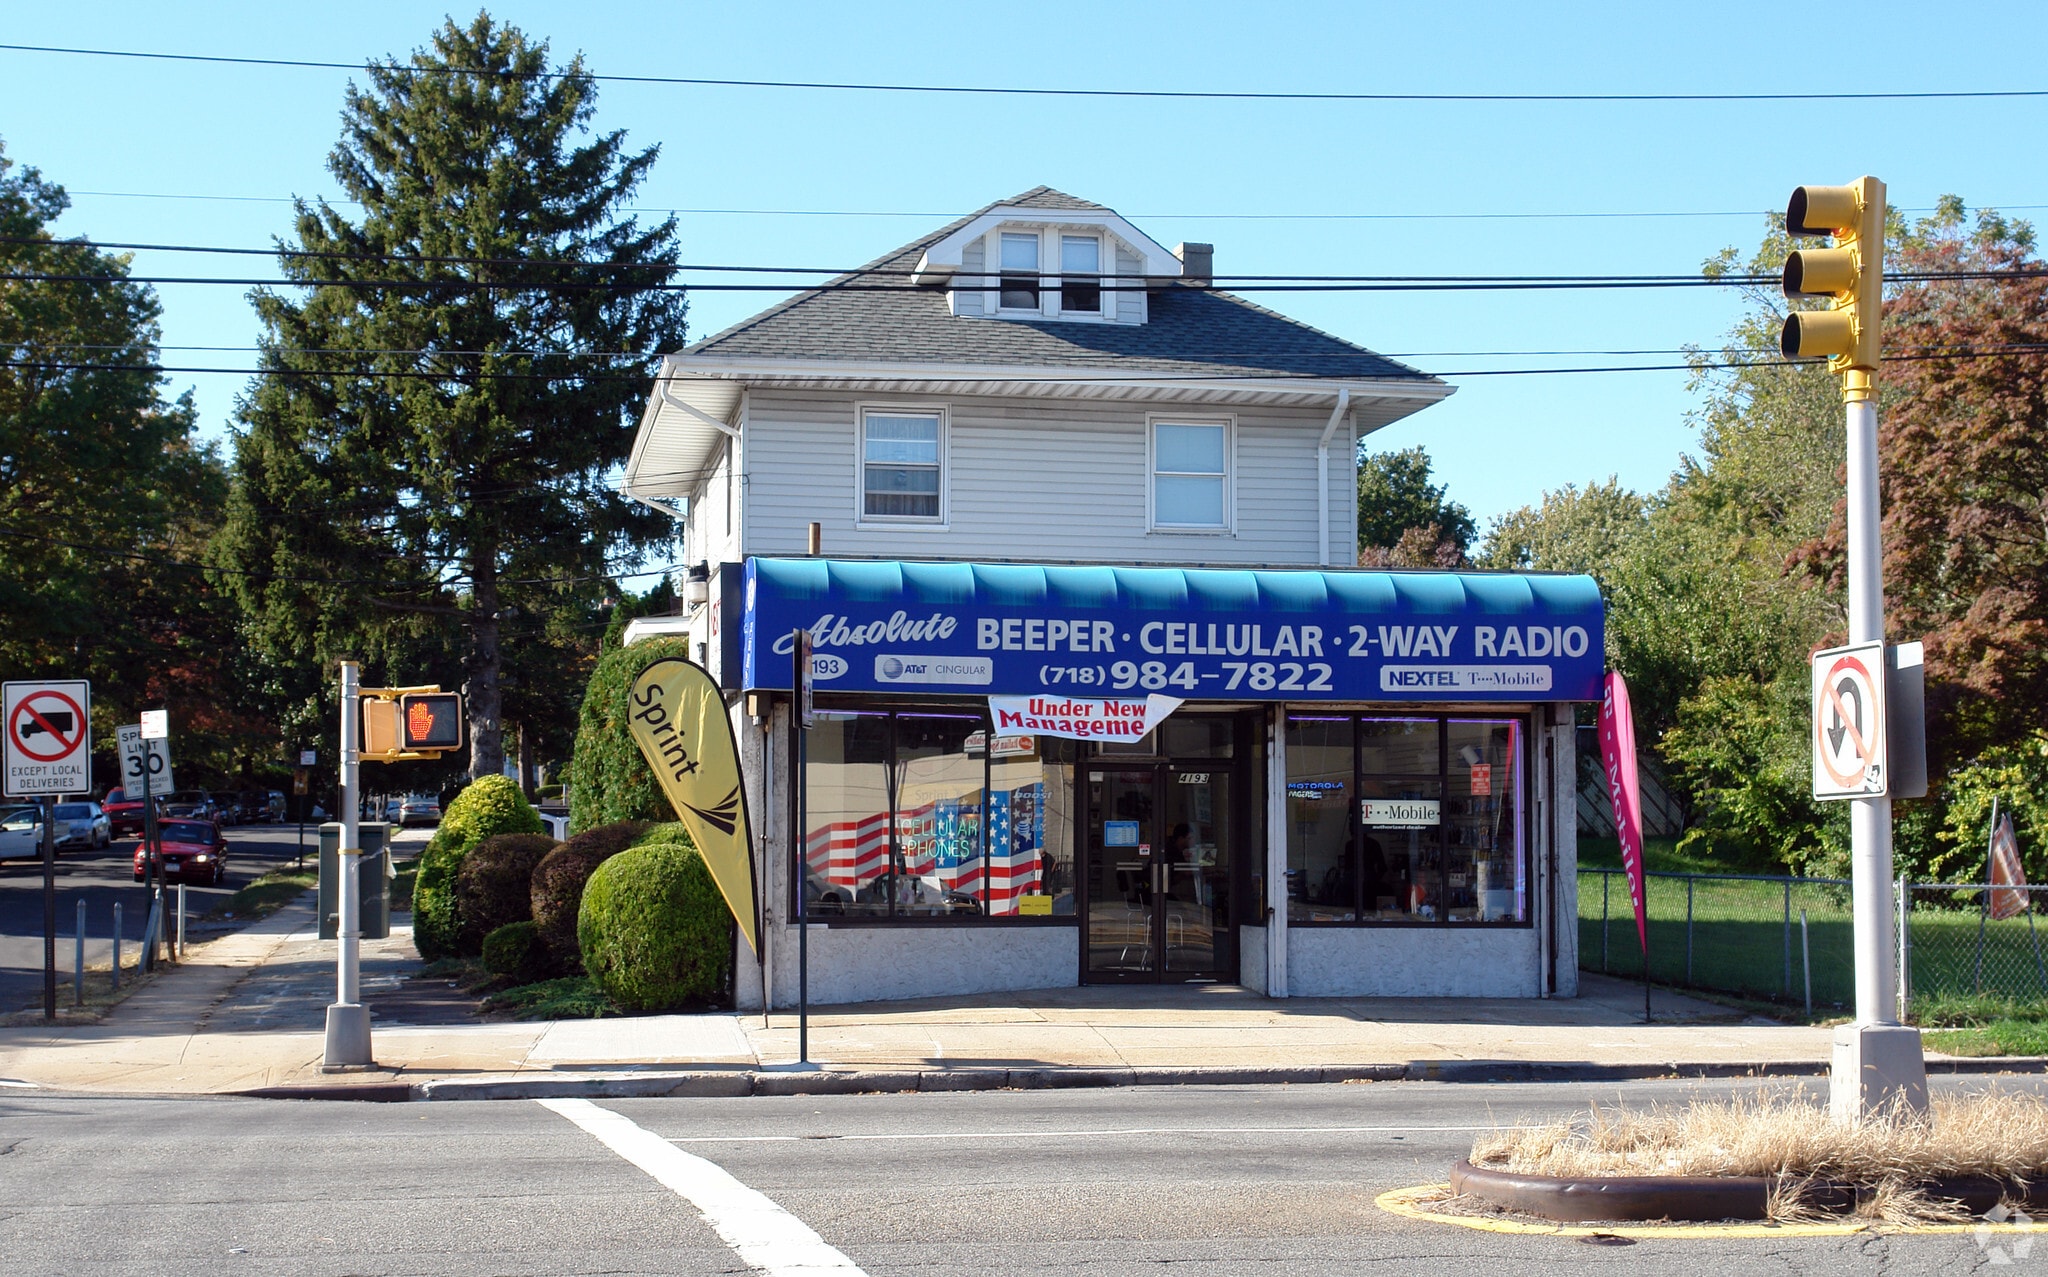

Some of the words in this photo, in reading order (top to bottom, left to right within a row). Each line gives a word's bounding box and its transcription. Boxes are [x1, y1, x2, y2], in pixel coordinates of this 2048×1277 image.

[772, 610, 958, 655] Absolute
[977, 618, 1115, 653] BEEPER
[1140, 621, 1323, 657] CELLULAR
[1348, 625, 1459, 658] 2-WAY
[1475, 626, 1589, 658] RADIO
[812, 659, 839, 675] 193
[904, 664, 928, 675] AT&T
[935, 664, 986, 675] CINGULAR
[1039, 665, 1105, 686] (718)
[1110, 660, 1333, 692] 984-7822
[1389, 671, 1460, 686] NEXTEL
[1029, 698, 1093, 716] Under
[1103, 700, 1146, 717] New
[998, 709, 1145, 737] Manageme
[122, 732, 142, 742] SPE
[634, 683, 700, 783] Sprint
[12, 766, 47, 776] EXCEPT
[52, 765, 82, 775] LOCAL
[127, 753, 163, 777] 30
[20, 778, 74, 788] DELIVERIES
[1180, 774, 1208, 783] 4193
[1288, 781, 1344, 789] MOTOROLA
[1013, 788, 1053, 800] boost
[900, 819, 978, 837] CELLULAR
[907, 838, 970, 857] PHONES
